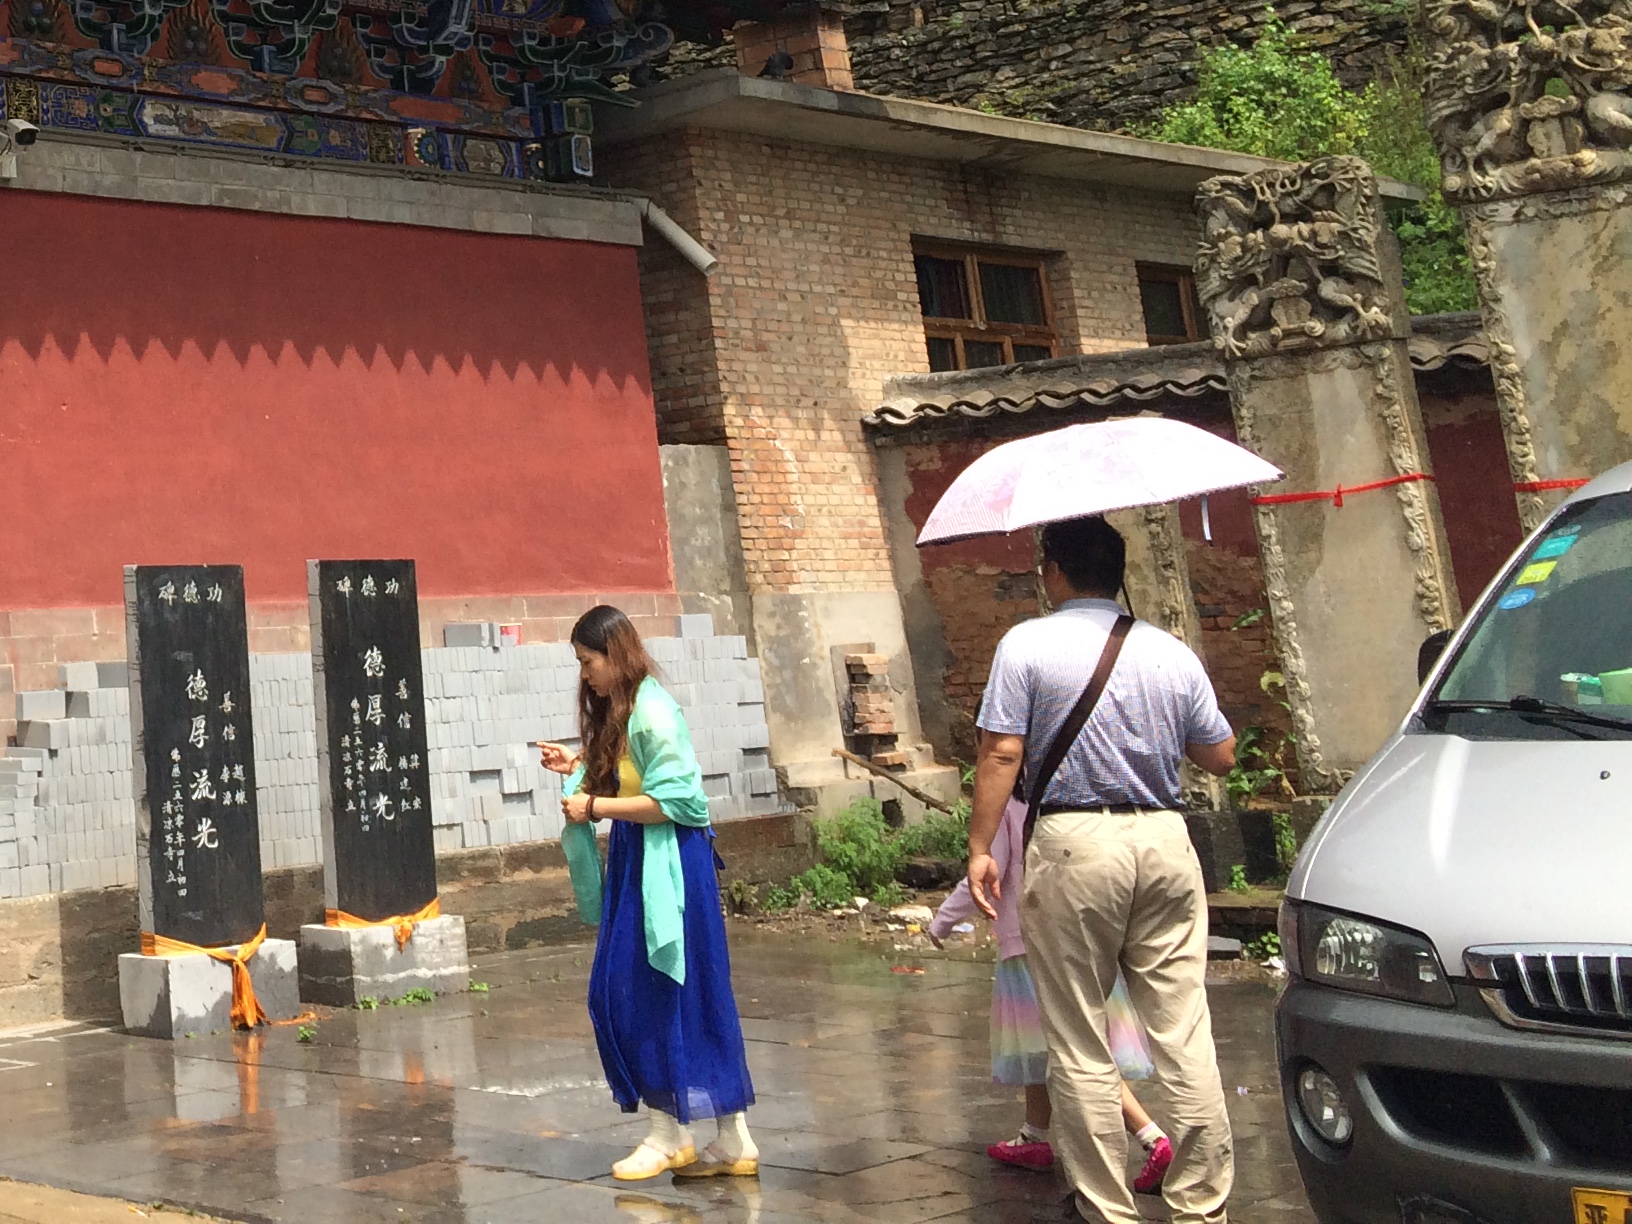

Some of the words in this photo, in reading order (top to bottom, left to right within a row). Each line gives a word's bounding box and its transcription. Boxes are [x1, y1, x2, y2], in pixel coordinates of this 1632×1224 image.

[158, 580, 222, 607] 功德碑
[336, 574, 399, 598] 功德碑
[185, 668, 218, 849] 德厚流光
[363, 645, 395, 821] 德厚流光
